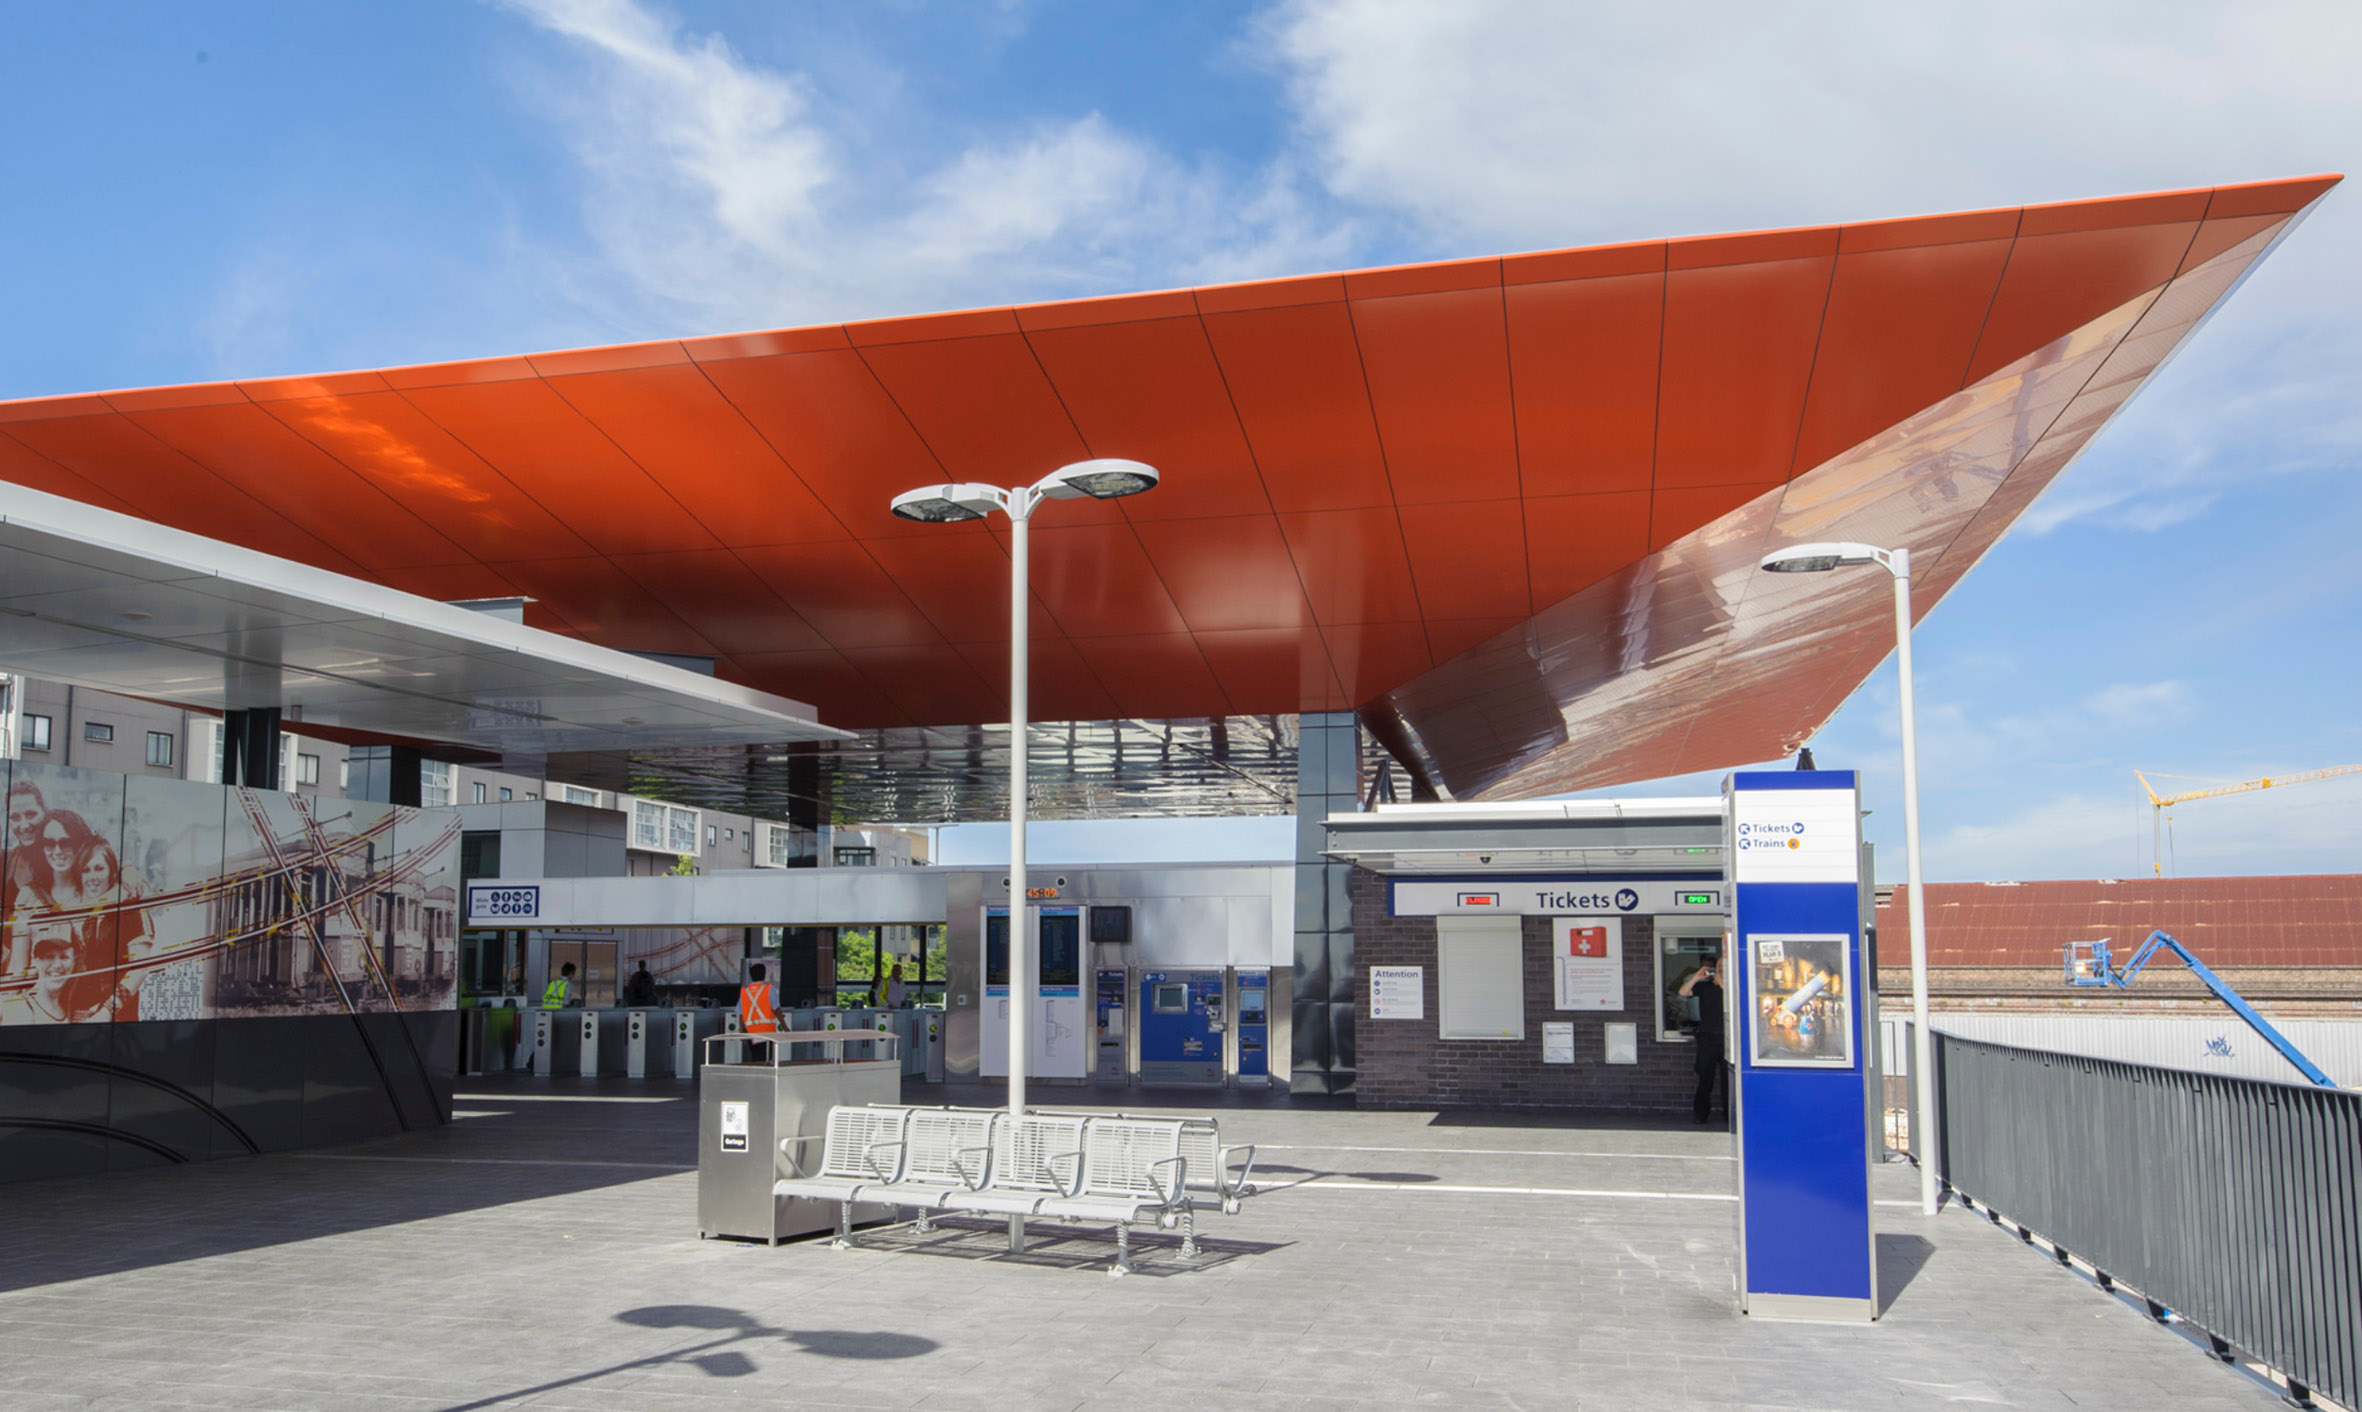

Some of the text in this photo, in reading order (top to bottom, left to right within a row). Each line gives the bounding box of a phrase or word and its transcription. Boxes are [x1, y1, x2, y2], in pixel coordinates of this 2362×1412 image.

[1753, 823, 1790, 833] Tickets
[1753, 838, 1785, 848] Trains
[1536, 891, 1610, 909] Tickets
[1687, 895, 1708, 903] OPEN
[1190, 973, 1221, 981] Tickets
[1375, 969, 1419, 978] Attention
